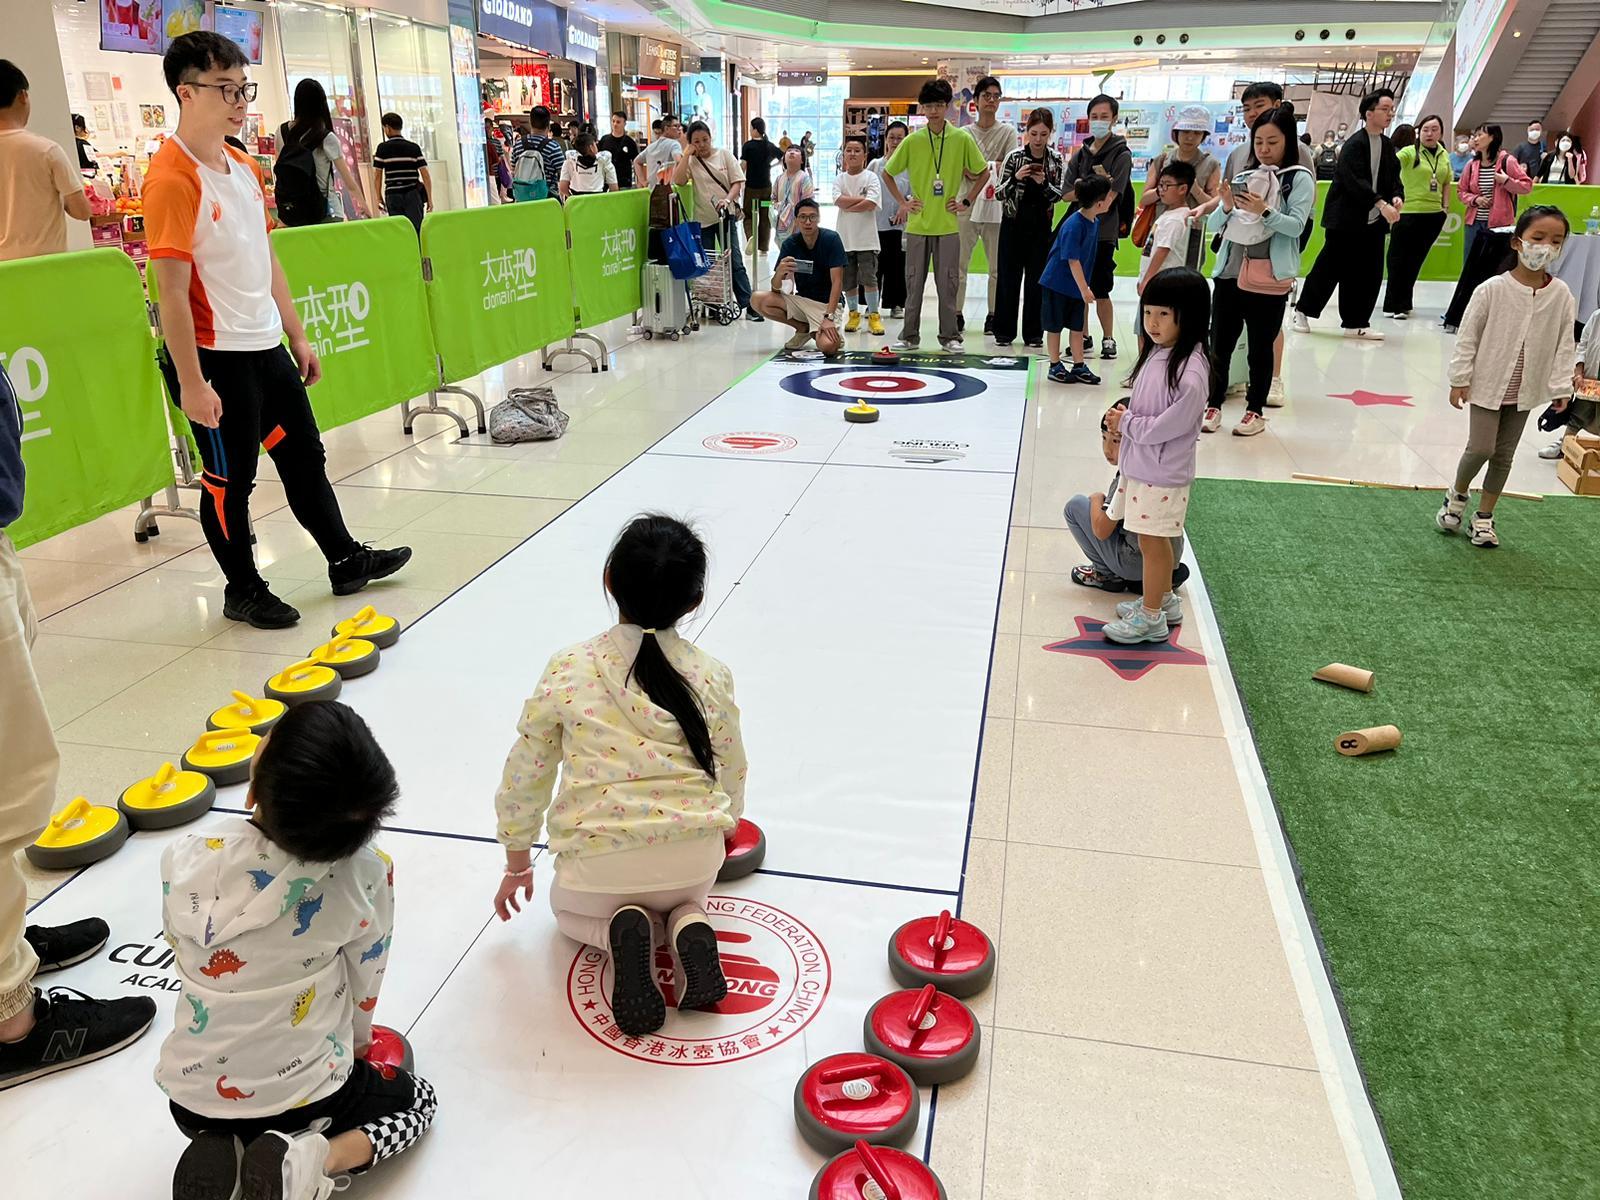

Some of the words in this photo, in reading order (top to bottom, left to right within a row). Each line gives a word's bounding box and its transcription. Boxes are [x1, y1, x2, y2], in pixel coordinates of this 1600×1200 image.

[481, 0, 533, 27] GIORDANO
[480, 248, 538, 301] 大本型
[292, 281, 370, 353] 本型
[483, 288, 517, 311] domain
[740, 904, 822, 977] FEDERATION,
[120, 973, 183, 992] ACAD
[577, 951, 603, 996] HONG
[778, 980, 821, 1025] CHINA
